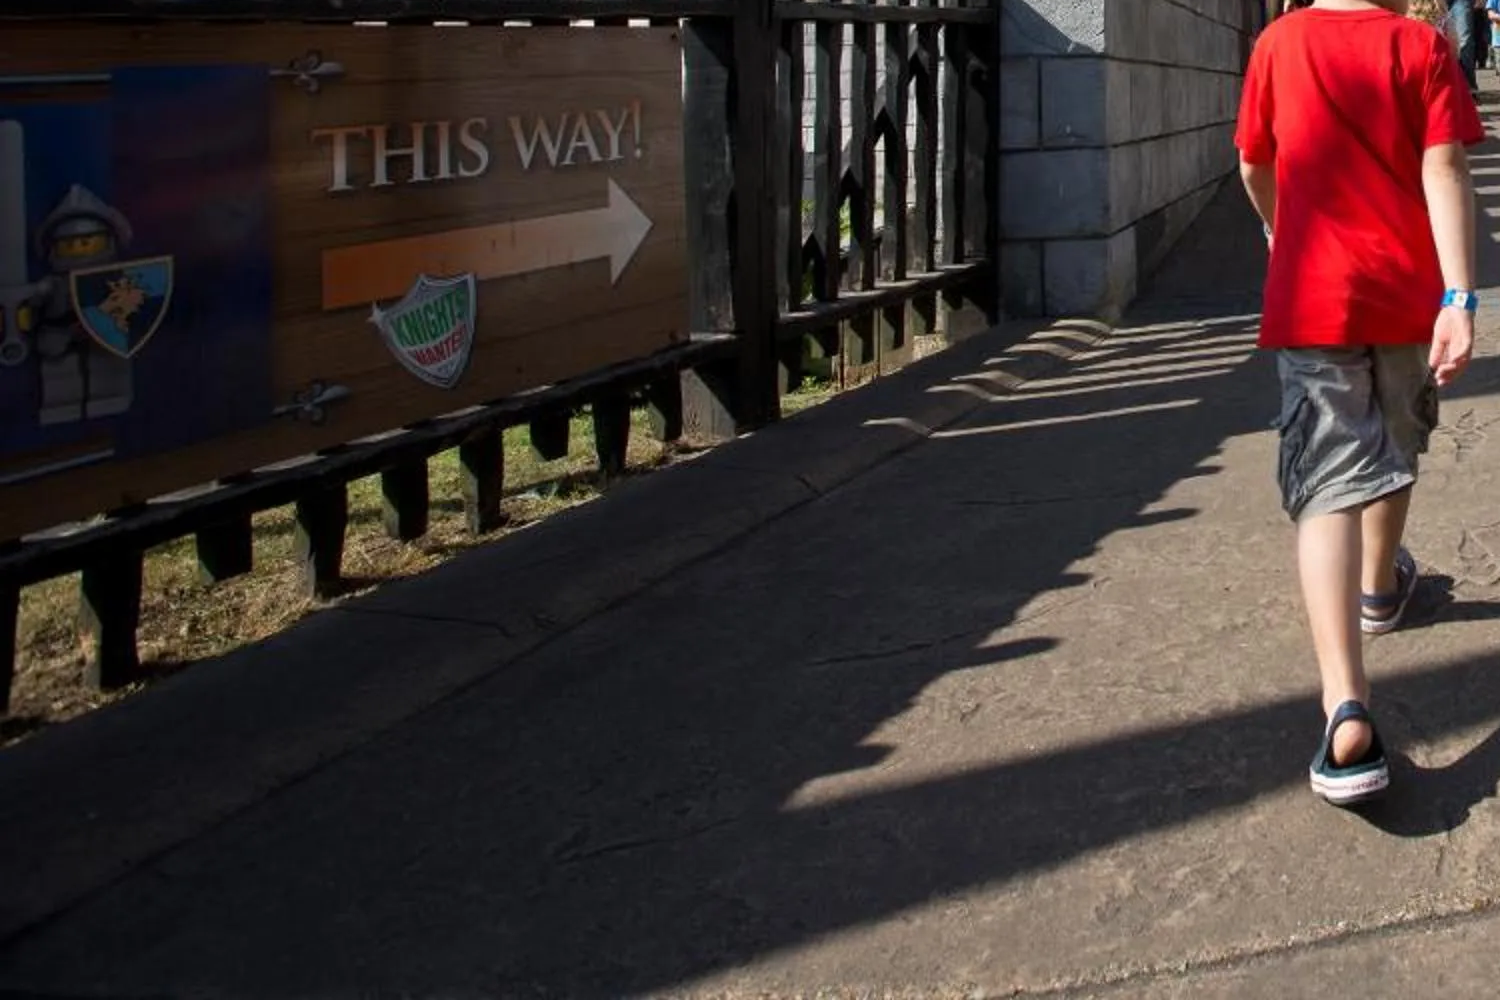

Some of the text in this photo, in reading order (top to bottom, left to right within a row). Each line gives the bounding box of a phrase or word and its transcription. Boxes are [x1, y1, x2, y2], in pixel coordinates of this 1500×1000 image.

[311, 99, 643, 192] THIS WAY!
[388, 287, 467, 348] KNIGHTS
